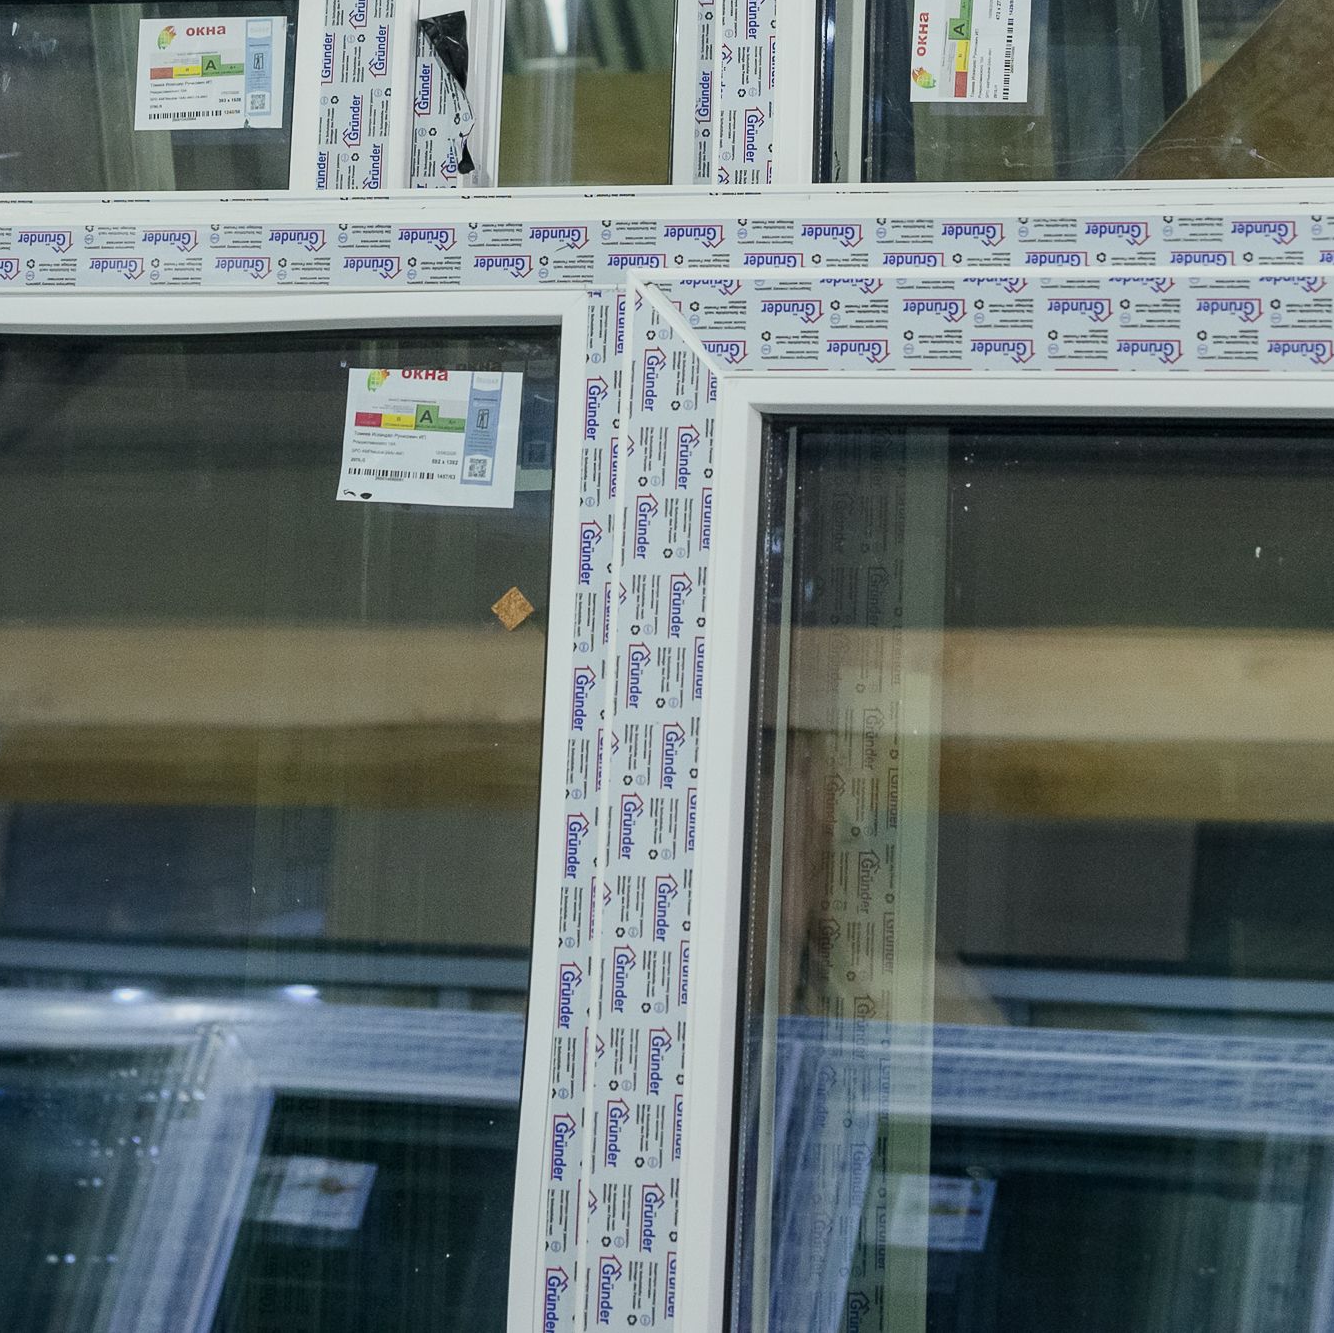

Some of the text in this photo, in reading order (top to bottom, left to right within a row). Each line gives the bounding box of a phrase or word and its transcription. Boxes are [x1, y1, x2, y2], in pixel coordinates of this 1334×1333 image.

[185, 25, 227, 37] окна
[916, 11, 930, 58] окна
[953, 22, 965, 37] A
[398, 228, 450, 242] Gründer
[663, 226, 717, 239] Gründer
[941, 224, 997, 238] Gründer
[474, 257, 526, 270] Gründer
[743, 254, 798, 268] Gründer
[761, 303, 816, 317] Gründer
[903, 300, 960, 314] Gründer
[826, 343, 883, 357] Gründer
[646, 355, 660, 411] Gründer
[586, 384, 600, 441] Gründer
[680, 432, 694, 490] Gründer
[580, 528, 594, 586] Gründer
[664, 730, 681, 789] Gründer
[565, 819, 582, 880] Gründer
[551, 1120, 569, 1182] Gründer
[643, 1191, 658, 1253] Gründer
